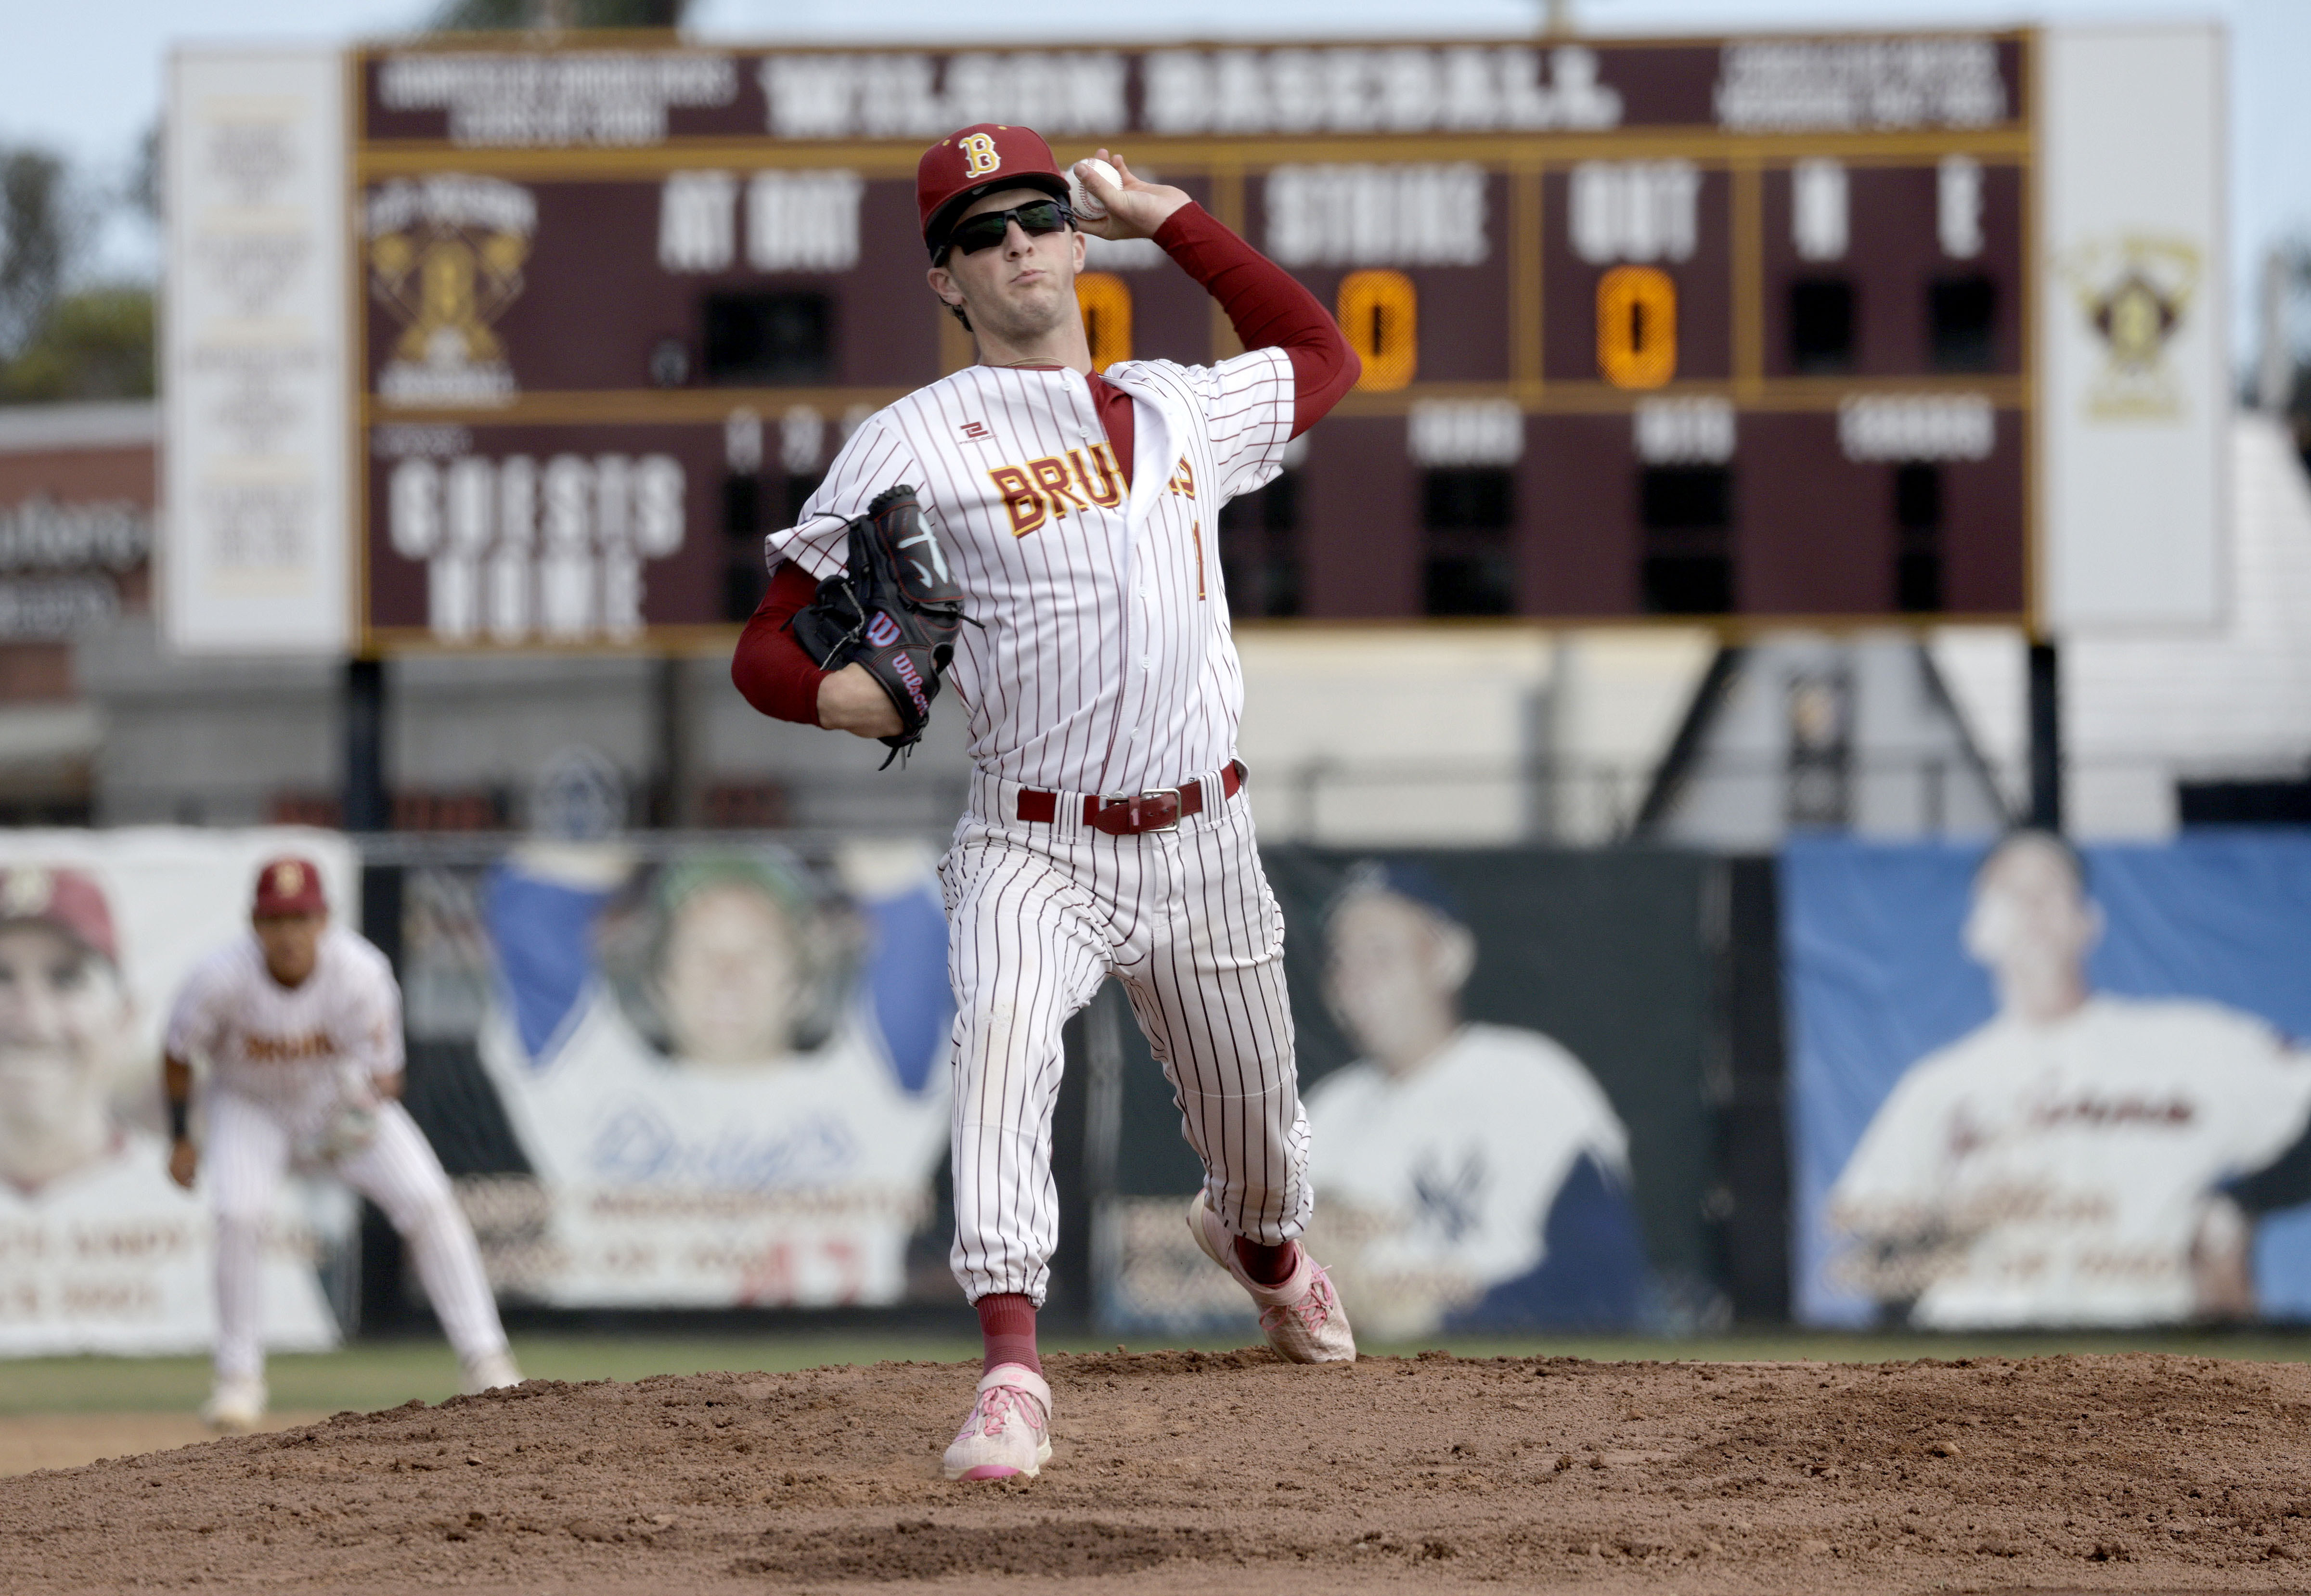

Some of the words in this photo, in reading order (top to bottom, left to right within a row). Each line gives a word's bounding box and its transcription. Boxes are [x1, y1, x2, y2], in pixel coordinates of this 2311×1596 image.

[763, 48, 1124, 139] WILSON
[1146, 46, 1622, 134] BASEBALL
[959, 133, 1001, 178] B
[1268, 164, 1485, 267] STRIKE
[1569, 160, 1699, 265] OUT
[1337, 270, 1417, 391] 0
[1596, 265, 1676, 389] 0
[390, 452, 684, 561] GUESTS
[427, 546, 645, 643] HOME
[1193, 520, 1206, 601] 1
[866, 610, 903, 648] W
[892, 651, 930, 717] Wilson
